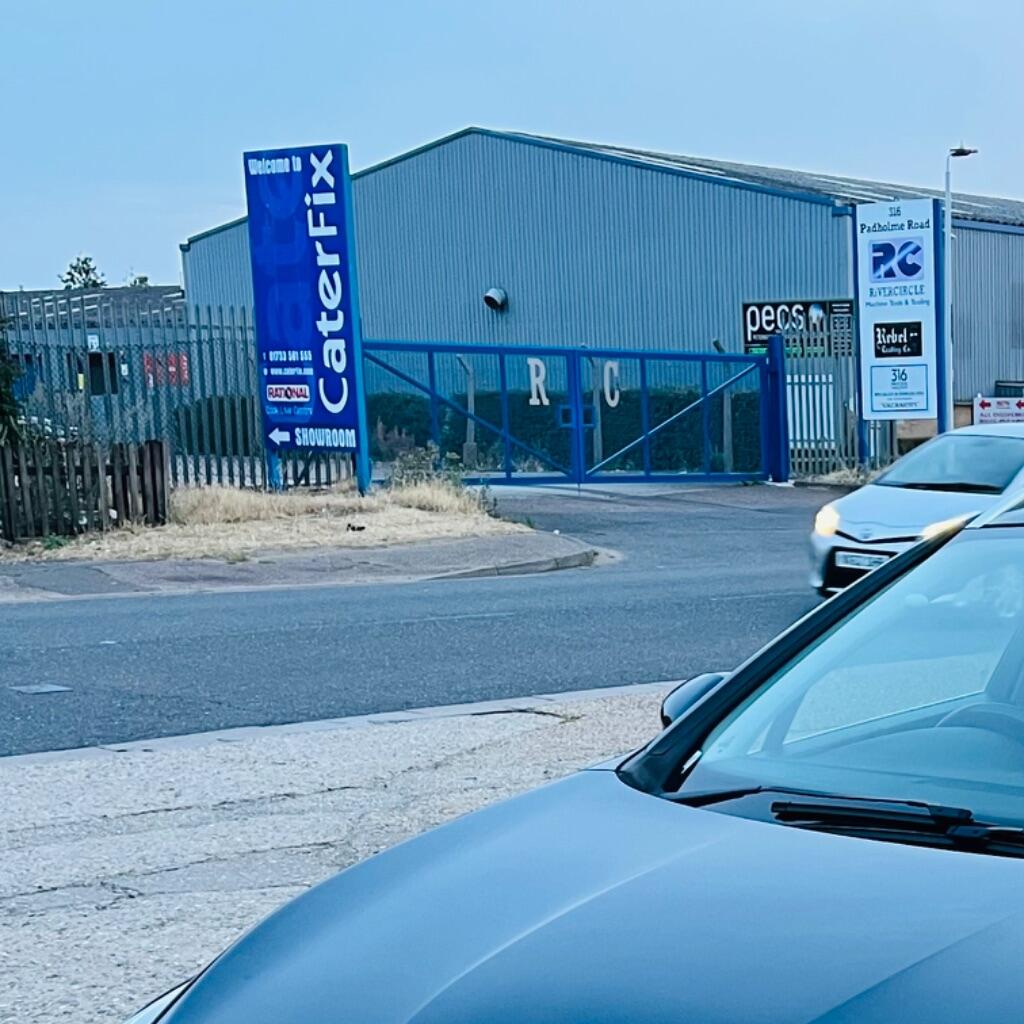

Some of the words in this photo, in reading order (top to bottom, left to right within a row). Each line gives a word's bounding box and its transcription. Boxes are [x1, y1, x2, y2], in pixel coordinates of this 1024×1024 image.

[248, 157, 290, 175] Welcome
[291, 155, 302, 172] to
[860, 221, 905, 234] Padholme
[907, 218, 930, 230] Road
[304, 149, 348, 414] CaterFix
[746, 304, 804, 342] pecs
[527, 357, 550, 405] R
[604, 361, 620, 408] C
[891, 369, 908, 382] 316
[268, 387, 308, 400] RATIONAL
[295, 427, 356, 447] SHOWROOM
